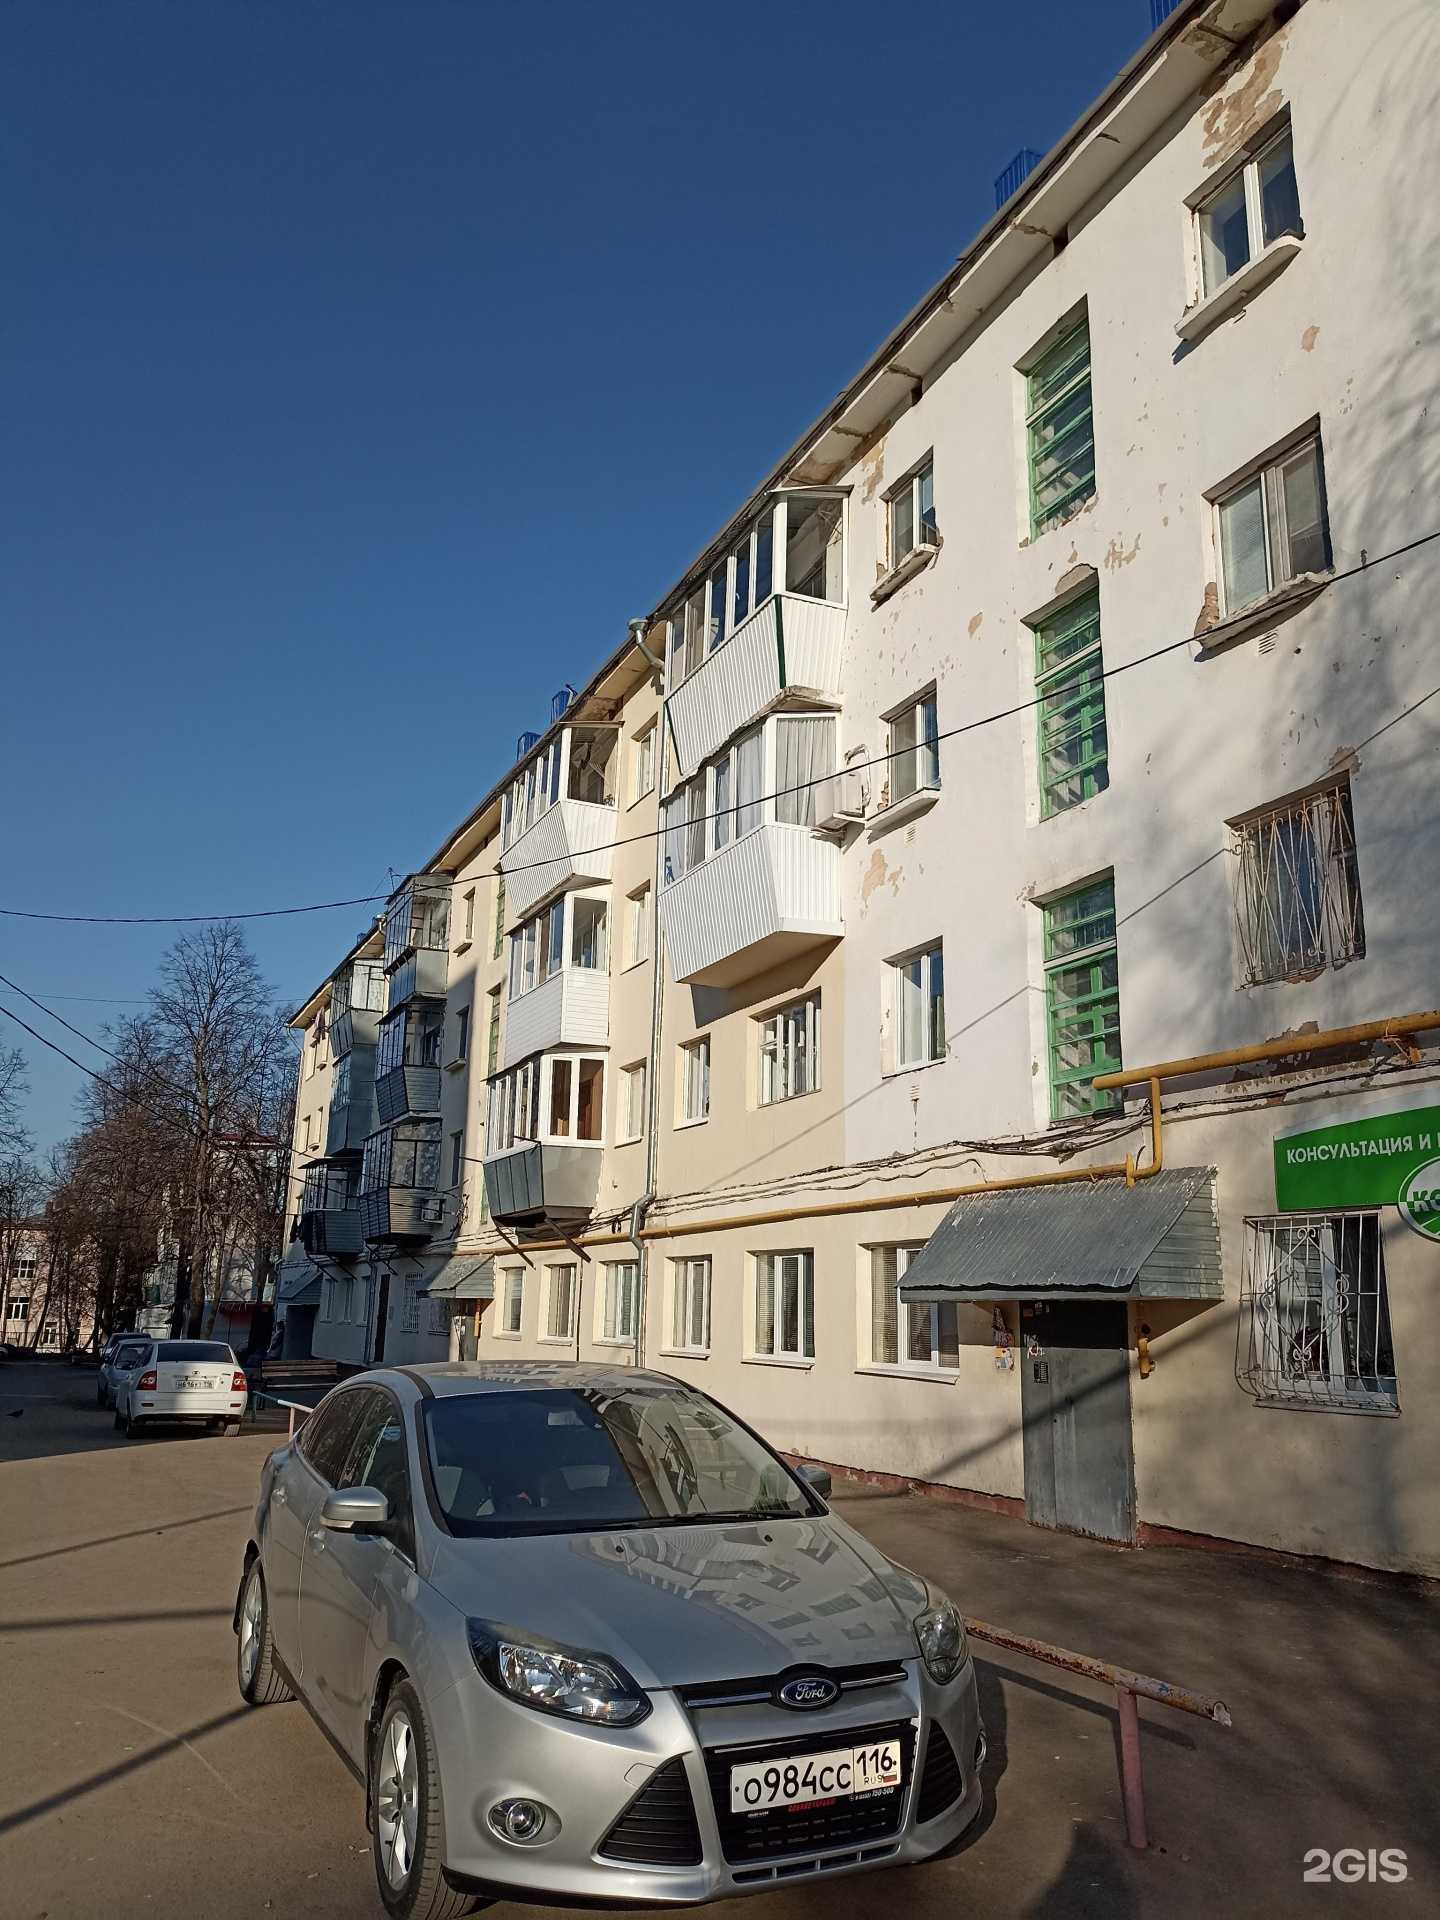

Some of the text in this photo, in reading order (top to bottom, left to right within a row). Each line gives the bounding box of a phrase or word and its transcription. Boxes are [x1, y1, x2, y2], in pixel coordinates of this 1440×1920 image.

[1286, 1136, 1412, 1163] КОНСУЛЬТАЦИЯ
[1419, 1133, 1431, 1150] И
[795, 1683, 825, 1700] Ford
[856, 1746, 893, 1776] 116
[863, 1774, 882, 1785] RUS
